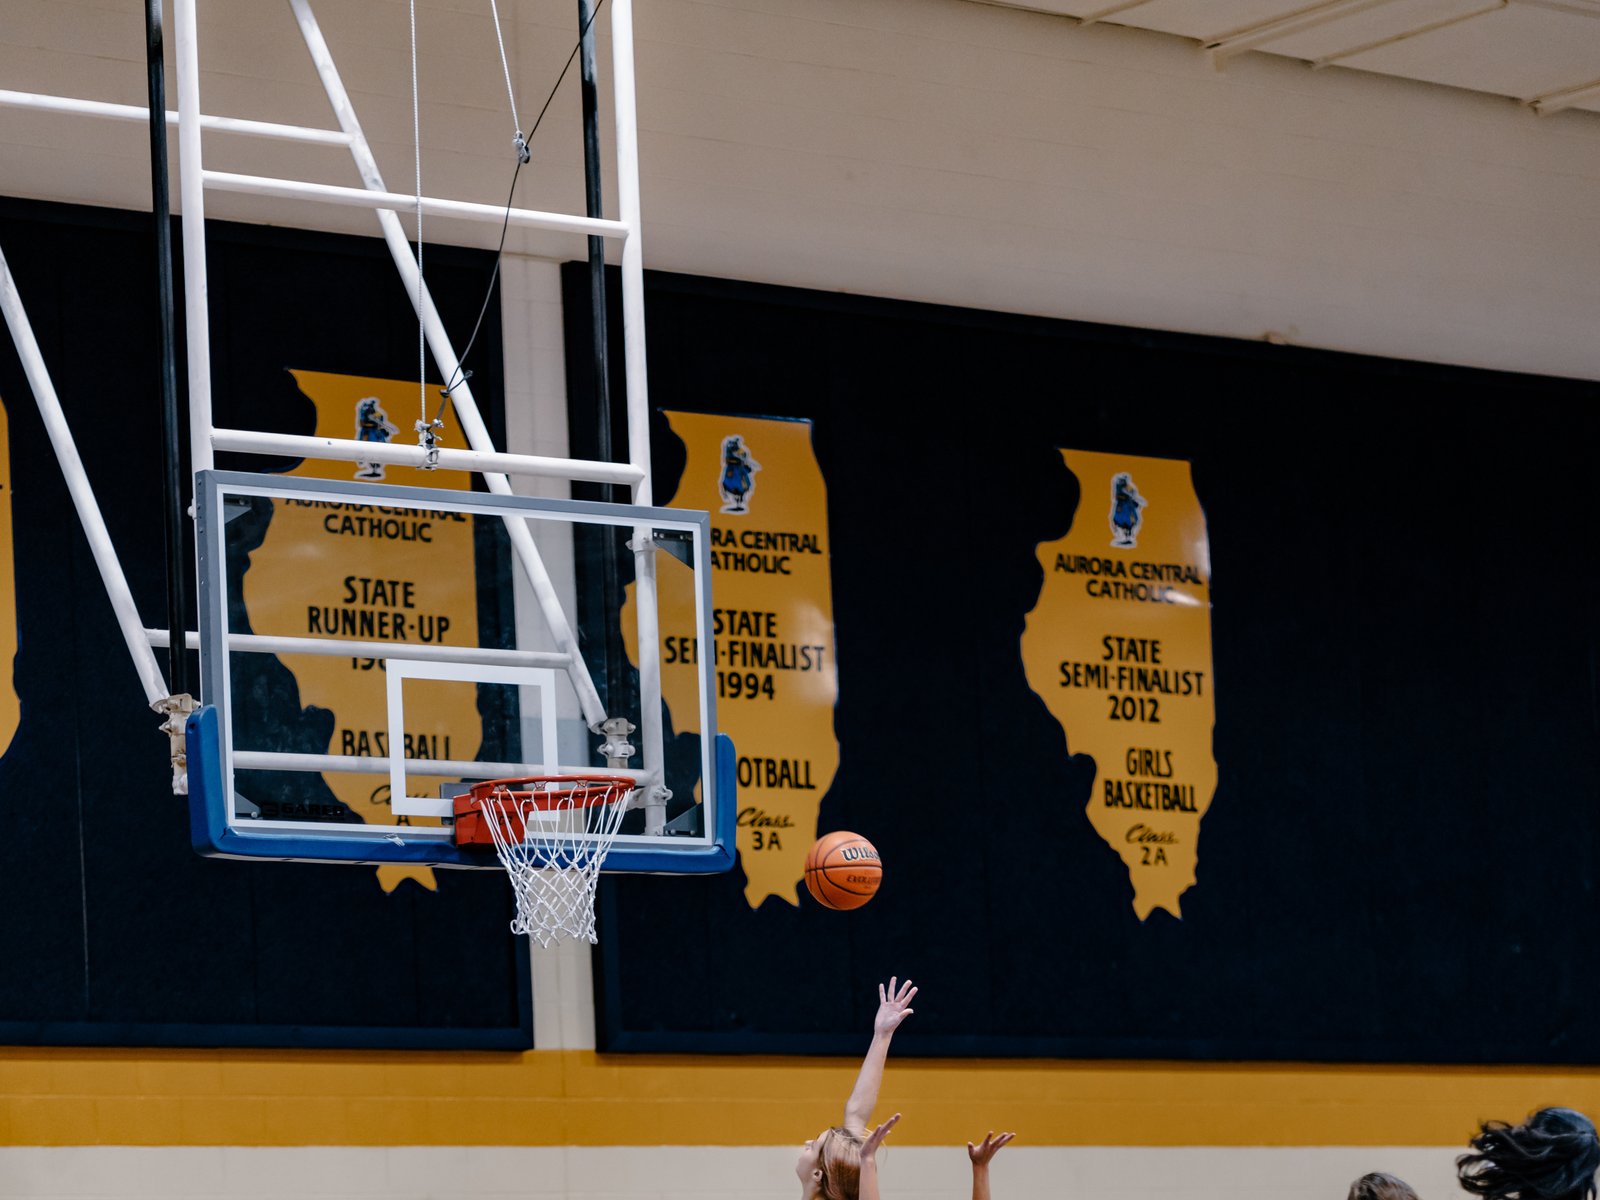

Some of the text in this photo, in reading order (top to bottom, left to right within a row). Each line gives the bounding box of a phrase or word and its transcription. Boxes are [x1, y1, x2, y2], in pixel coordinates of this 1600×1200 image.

[324, 514, 433, 543] CATHOLIC
[741, 530, 822, 555] CENTRAL
[711, 550, 792, 575] ATHOLIC
[1055, 553, 1202, 585] AURORA CENTRAL
[343, 576, 415, 609] STATE
[1086, 579, 1177, 604] CATHOLIC
[714, 609, 777, 638] STATE
[665, 636, 825, 672] SEI-FINALIST
[1103, 636, 1161, 664] STATE
[718, 672, 775, 700] 1994
[1109, 696, 1161, 723] 2012
[342, 729, 450, 760] BASBALL
[738, 757, 816, 790] OTBALL
[1127, 748, 1173, 778] GIRLS
[1104, 780, 1198, 813] BASKETBALL
[841, 846, 881, 862] Wilso
